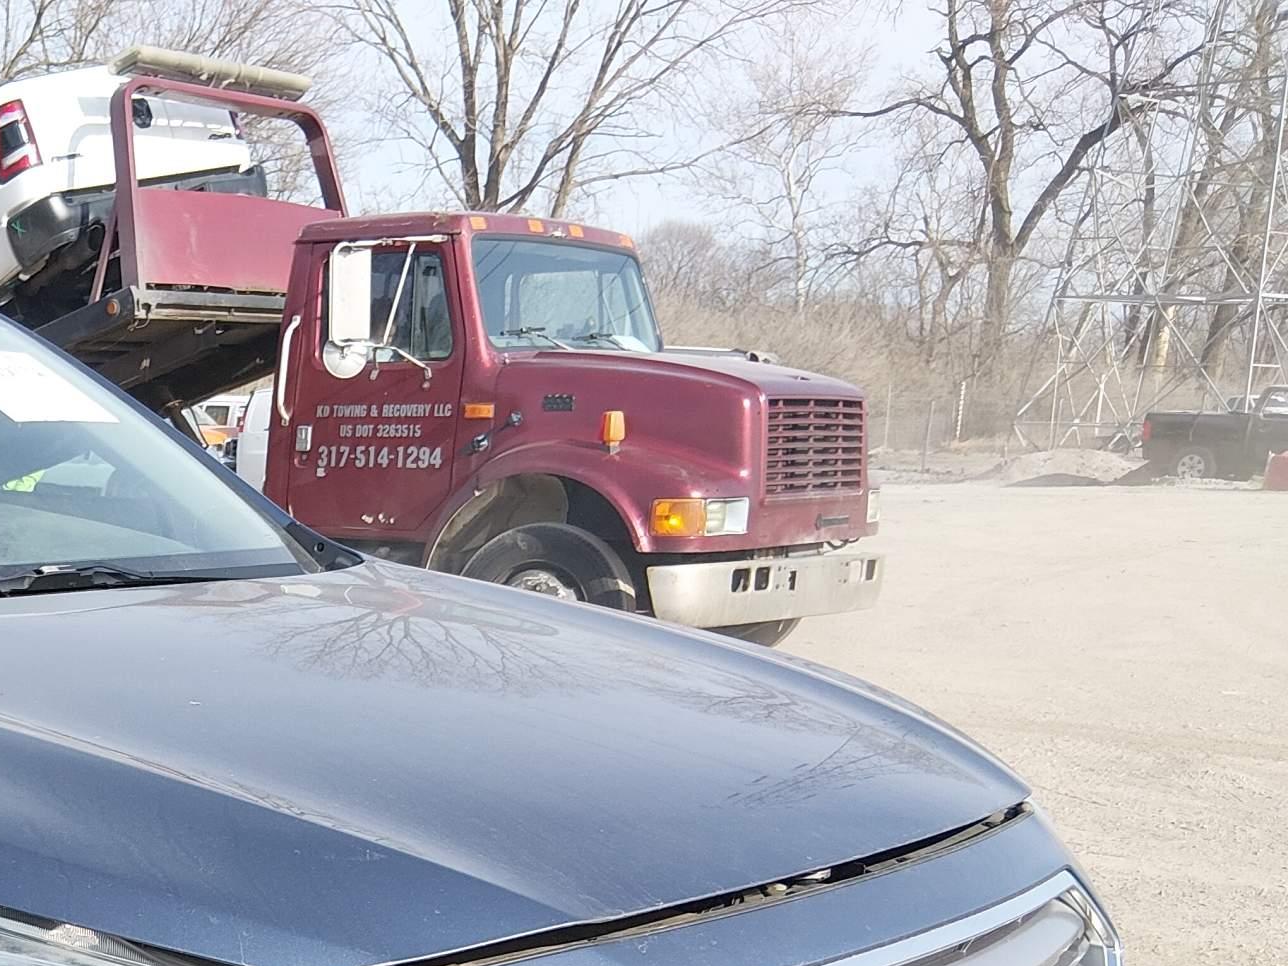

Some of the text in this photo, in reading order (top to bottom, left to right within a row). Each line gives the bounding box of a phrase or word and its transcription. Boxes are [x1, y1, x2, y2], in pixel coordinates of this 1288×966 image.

[316, 403, 453, 418] KD TOWING & RECOVERY LLC
[339, 424, 353, 438] US
[355, 424, 374, 438] DOT
[317, 445, 443, 469] 317-514-1294
